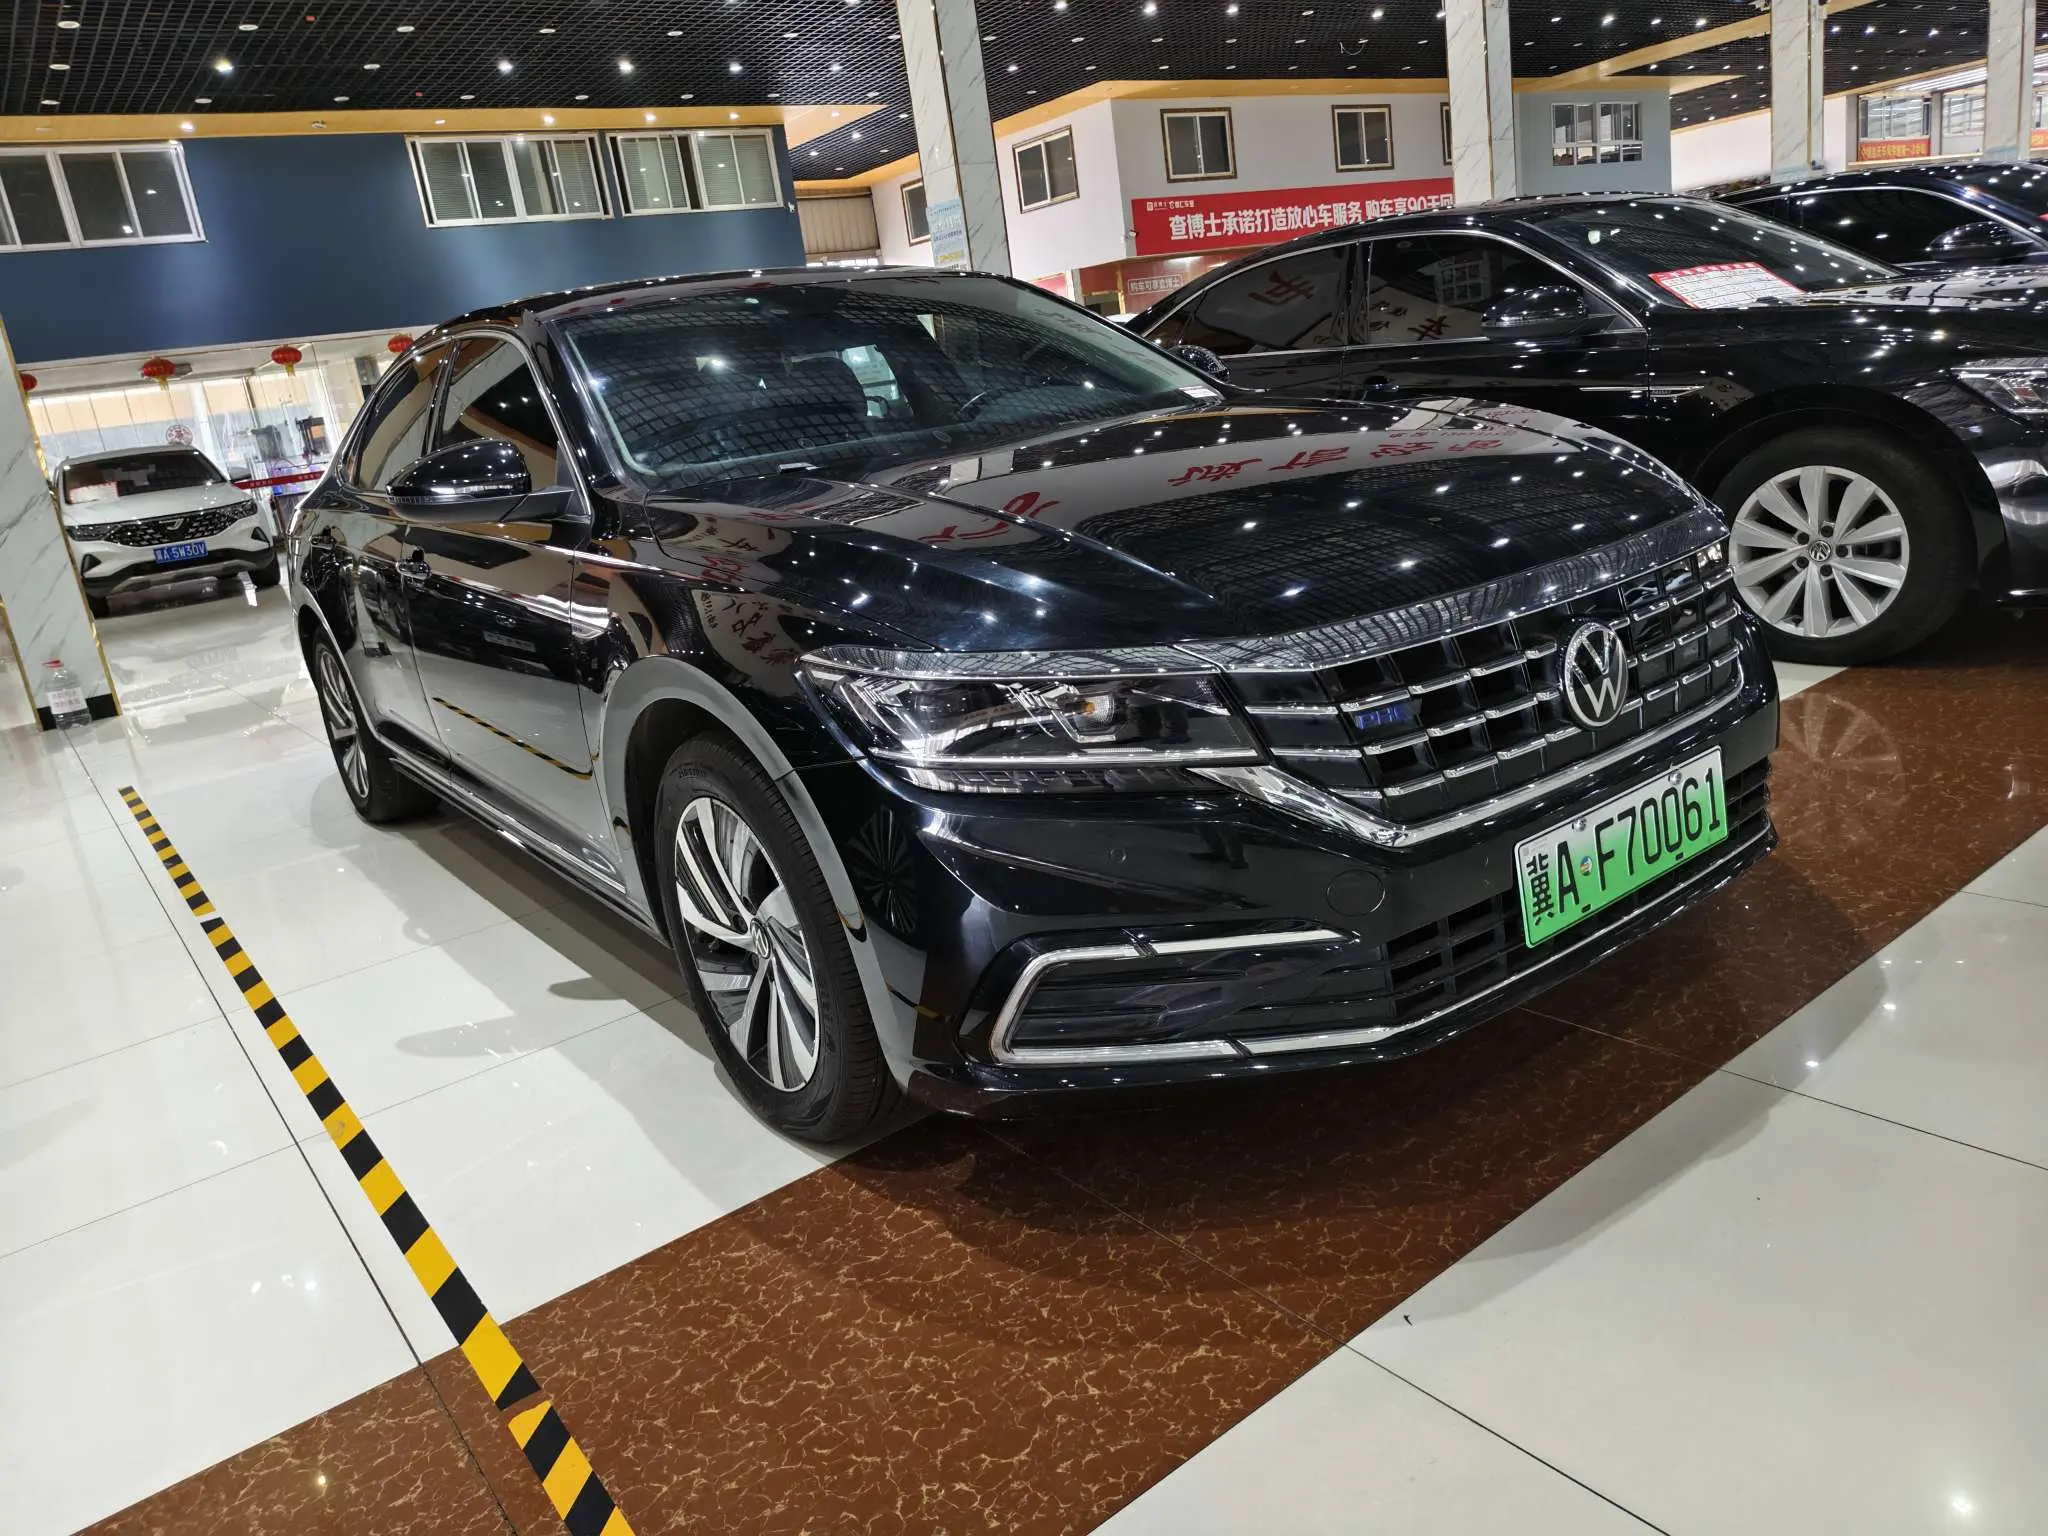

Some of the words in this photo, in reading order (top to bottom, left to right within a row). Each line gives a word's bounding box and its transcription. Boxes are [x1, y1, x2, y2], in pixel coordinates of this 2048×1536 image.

[1168, 202, 1362, 240] 查博士承诺打造放心车服务
